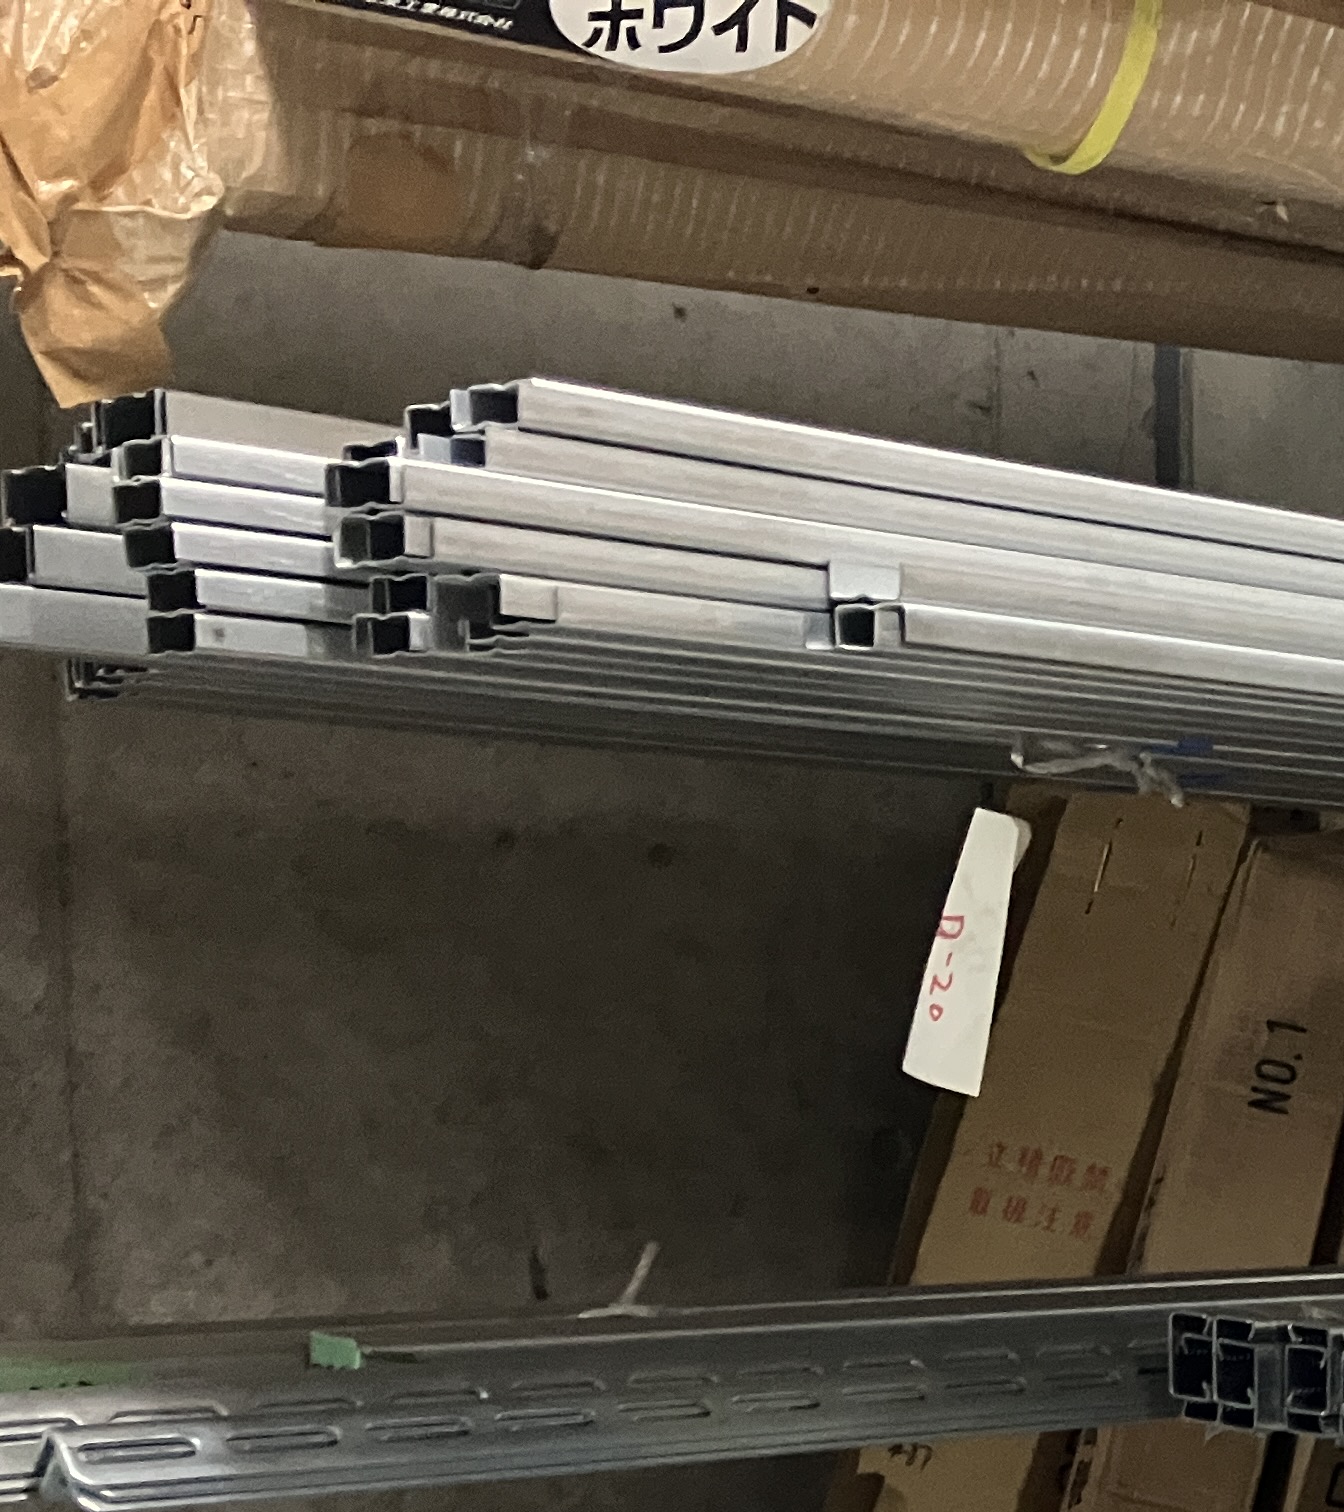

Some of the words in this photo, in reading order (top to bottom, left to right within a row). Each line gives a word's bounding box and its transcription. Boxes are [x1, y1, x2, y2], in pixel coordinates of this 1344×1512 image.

[582, 0, 817, 53] ホワイト
[1247, 1018, 1308, 1115] NO.1
